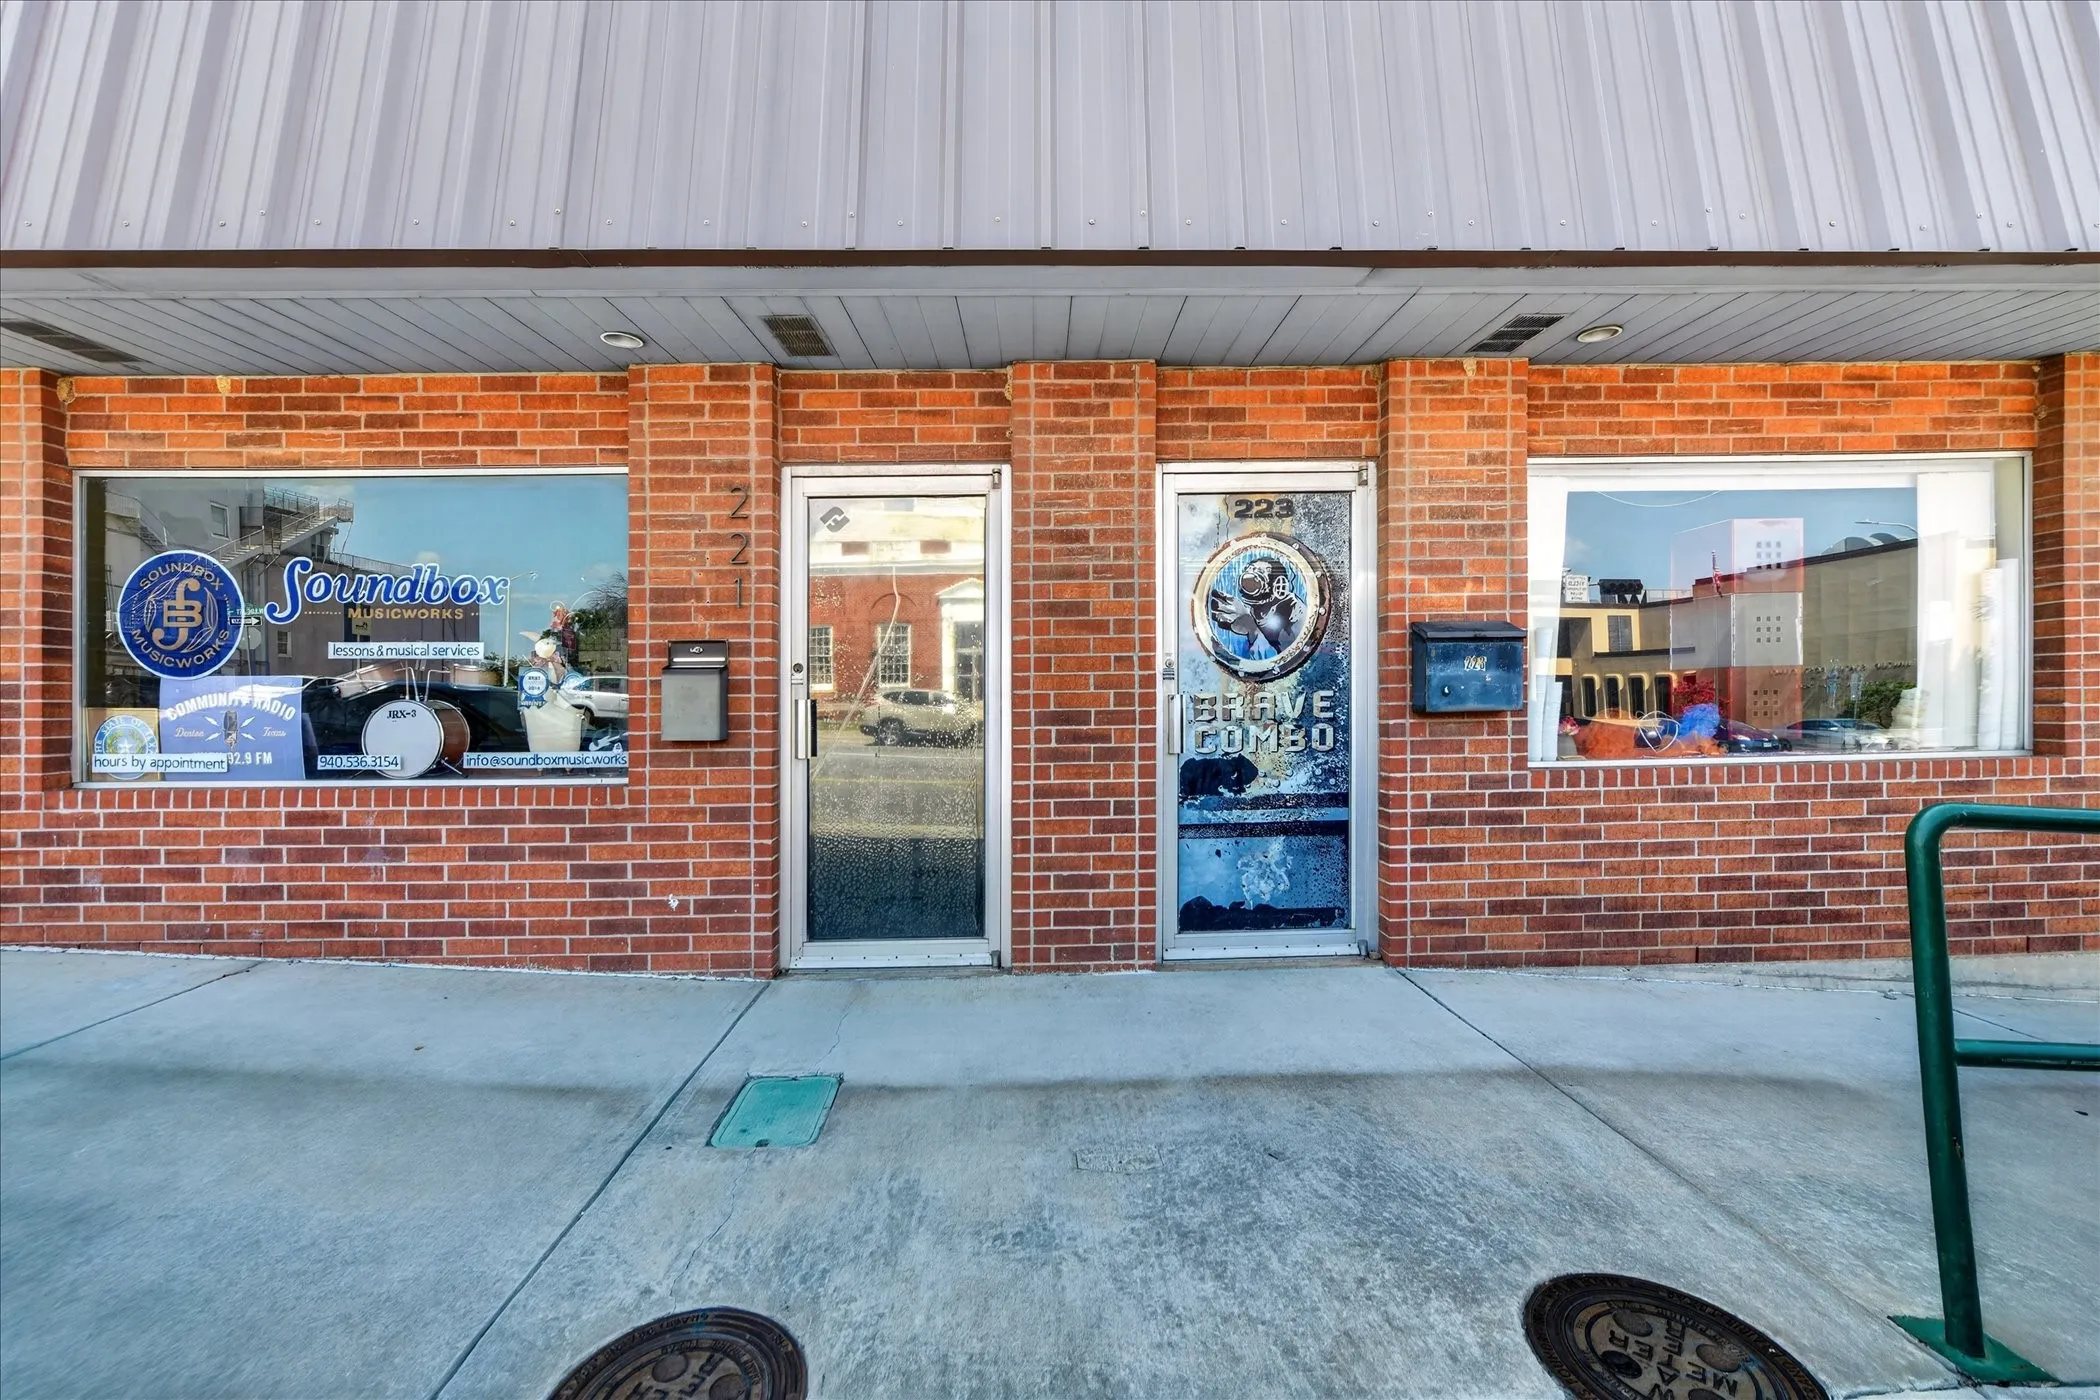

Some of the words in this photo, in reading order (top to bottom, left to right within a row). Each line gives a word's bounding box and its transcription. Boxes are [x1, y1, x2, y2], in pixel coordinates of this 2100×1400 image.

[1234, 497, 1294, 519] 223
[139, 562, 224, 591] SOUNDBOX
[265, 557, 510, 625] Soundbox
[347, 607, 464, 620] MUSICWORKS
[132, 629, 229, 669] MUSICWORKS
[333, 643, 376, 657] lessons
[386, 643, 429, 657] musical
[431, 643, 480, 657] services
[252, 695, 297, 721] RADIO
[387, 710, 417, 719] JRX-3
[1193, 689, 1335, 722] BRAVE
[1193, 722, 1335, 755] COMBO
[94, 756, 128, 768] hours
[131, 756, 146, 770] by
[150, 757, 226, 772] appointment
[227, 752, 253, 764] 92.9
[256, 752, 272, 764] FM
[319, 755, 400, 769] 940.536.3154
[465, 753, 628, 767] info@soundboxmusic.works
